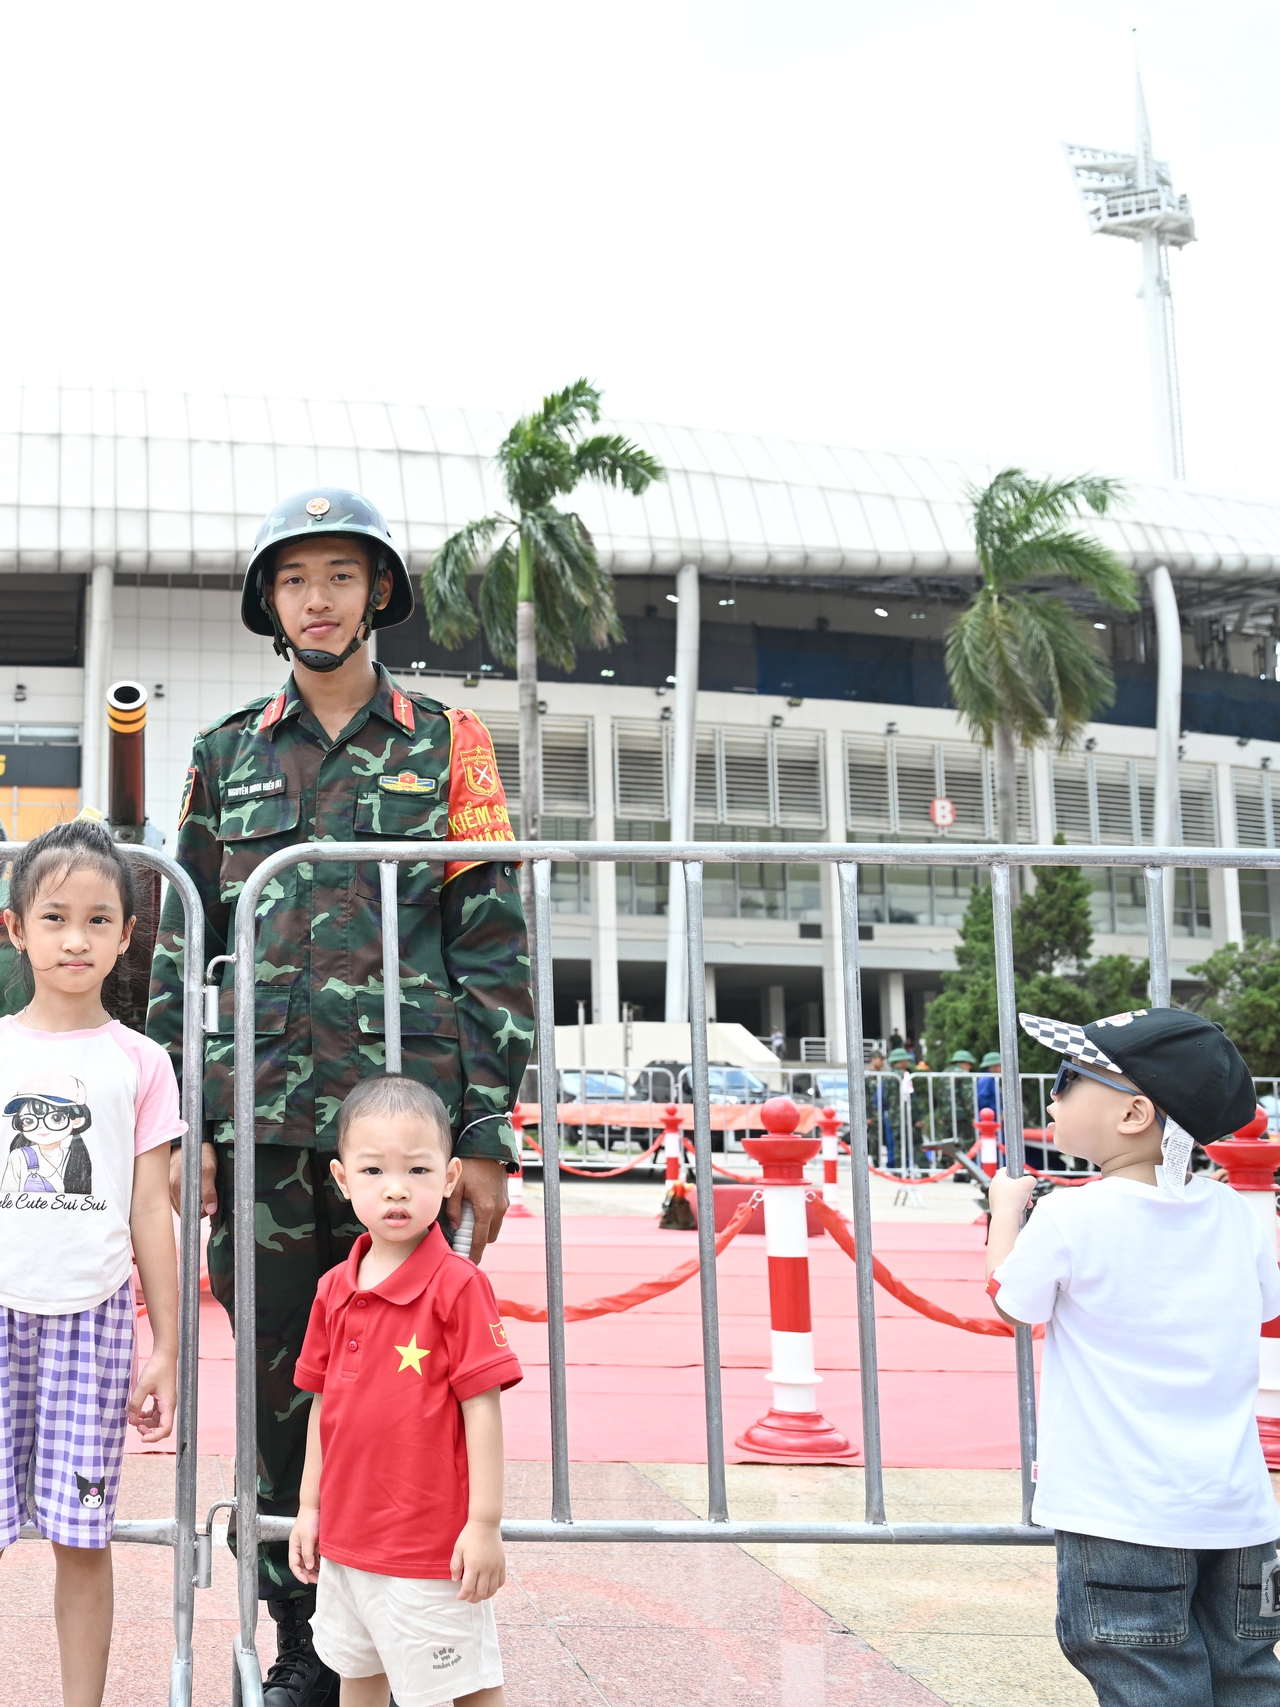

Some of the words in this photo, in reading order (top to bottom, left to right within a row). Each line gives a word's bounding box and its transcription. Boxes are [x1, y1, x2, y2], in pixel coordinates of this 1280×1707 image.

[448, 801, 492, 836] KIỂM
[935, 800, 953, 826] B
[15, 1193, 48, 1209] Cute
[51, 1193, 78, 1210] Sui
[80, 1195, 107, 1211] Sui
